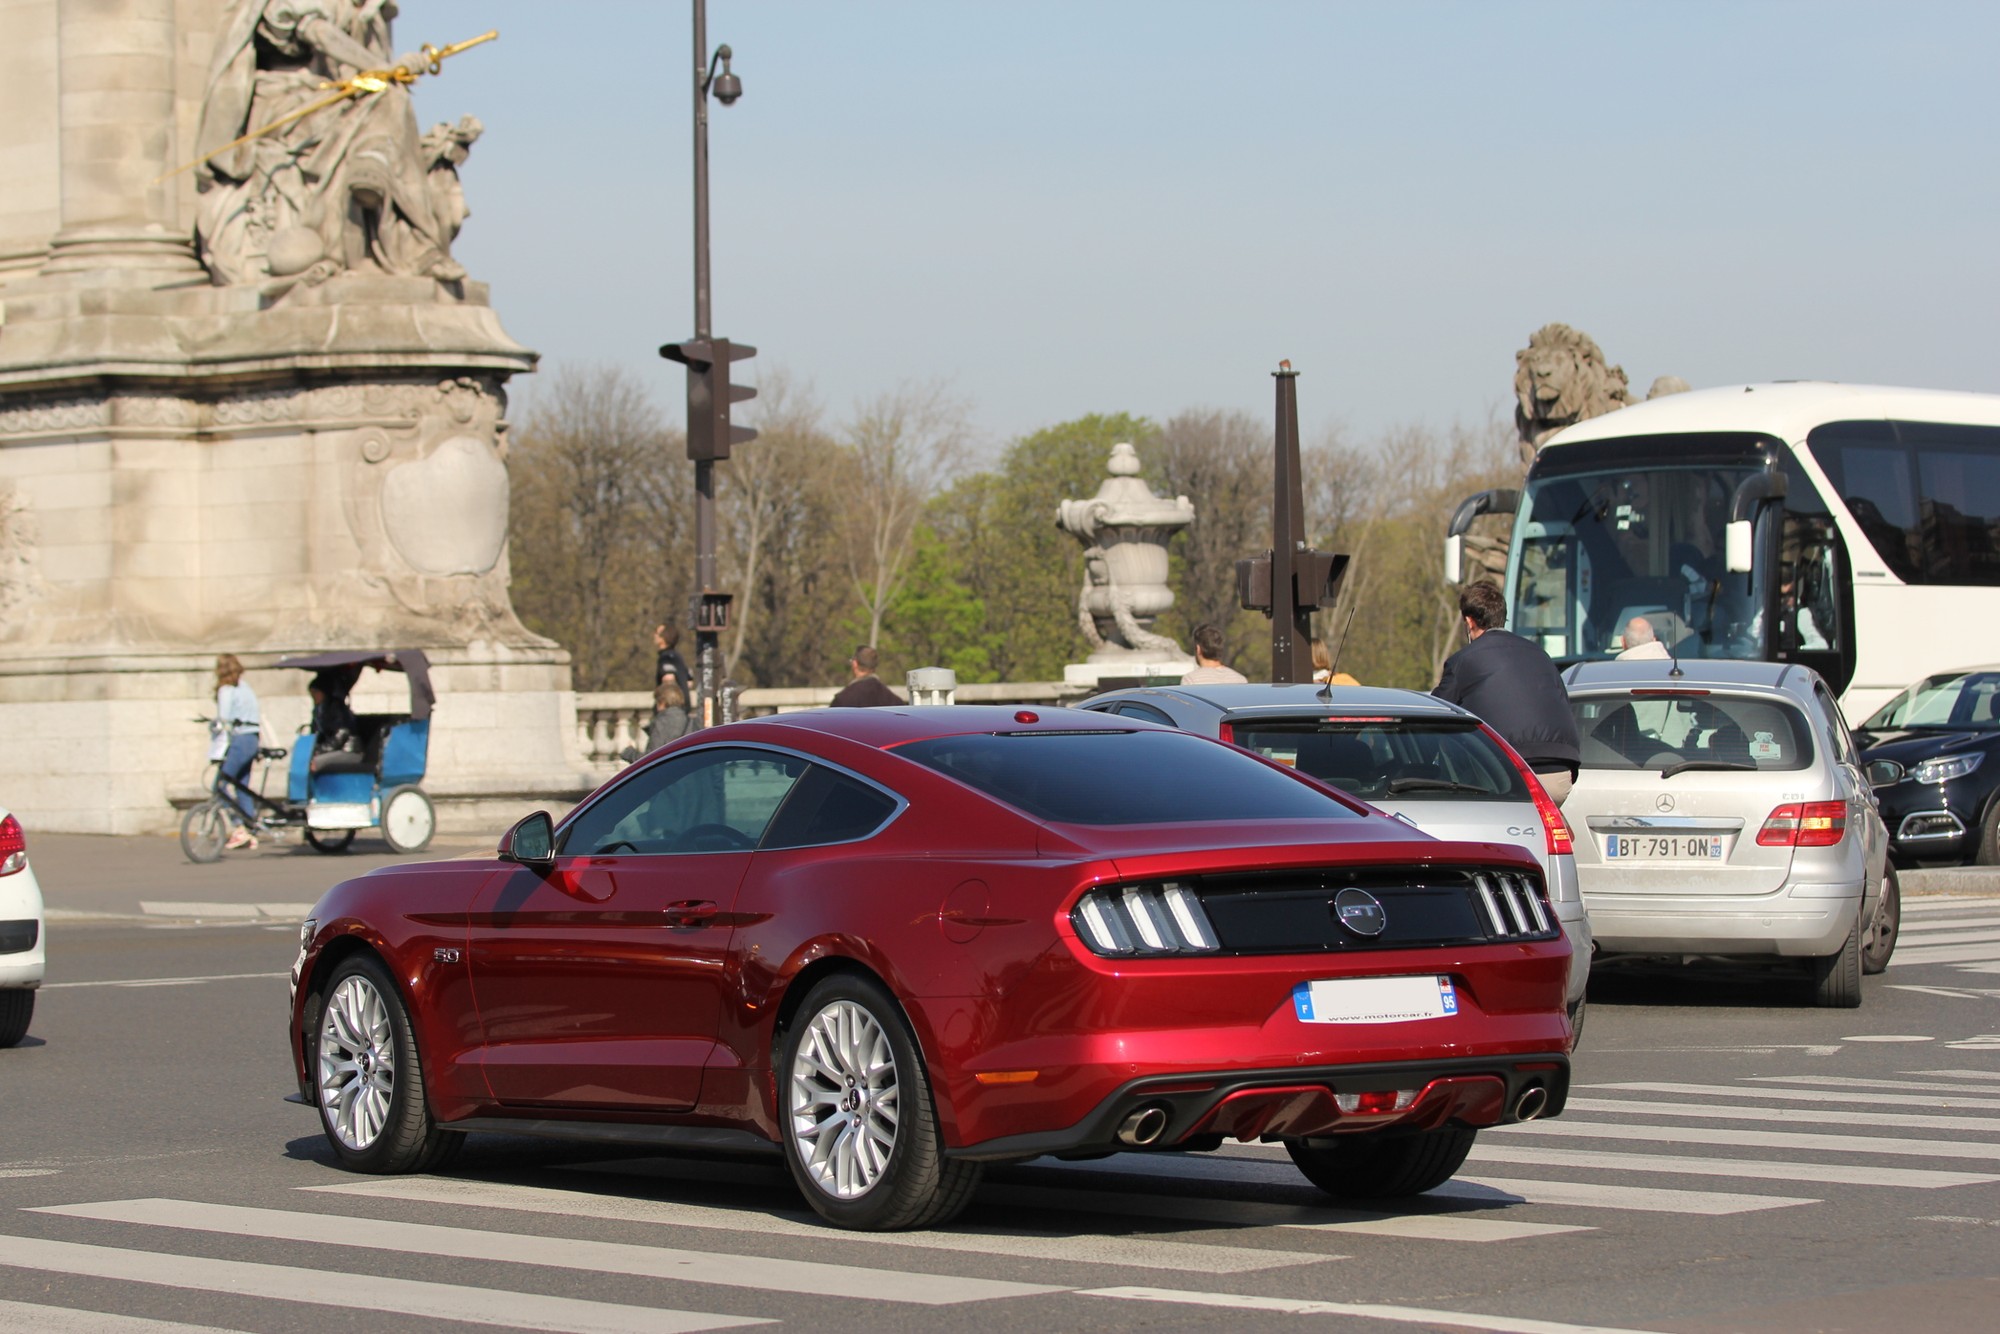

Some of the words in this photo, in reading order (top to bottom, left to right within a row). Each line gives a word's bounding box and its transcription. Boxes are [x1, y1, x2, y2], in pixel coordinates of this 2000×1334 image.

[1506, 825, 1537, 837] C4
[1620, 838, 1708, 857] BT-791-QN
[1711, 847, 1720, 856] 92
[1341, 904, 1377, 917] GT
[1443, 995, 1455, 1009] 95
[1301, 1004, 1308, 1014] F
[1328, 1012, 1433, 1021] www.motorcar.fr
